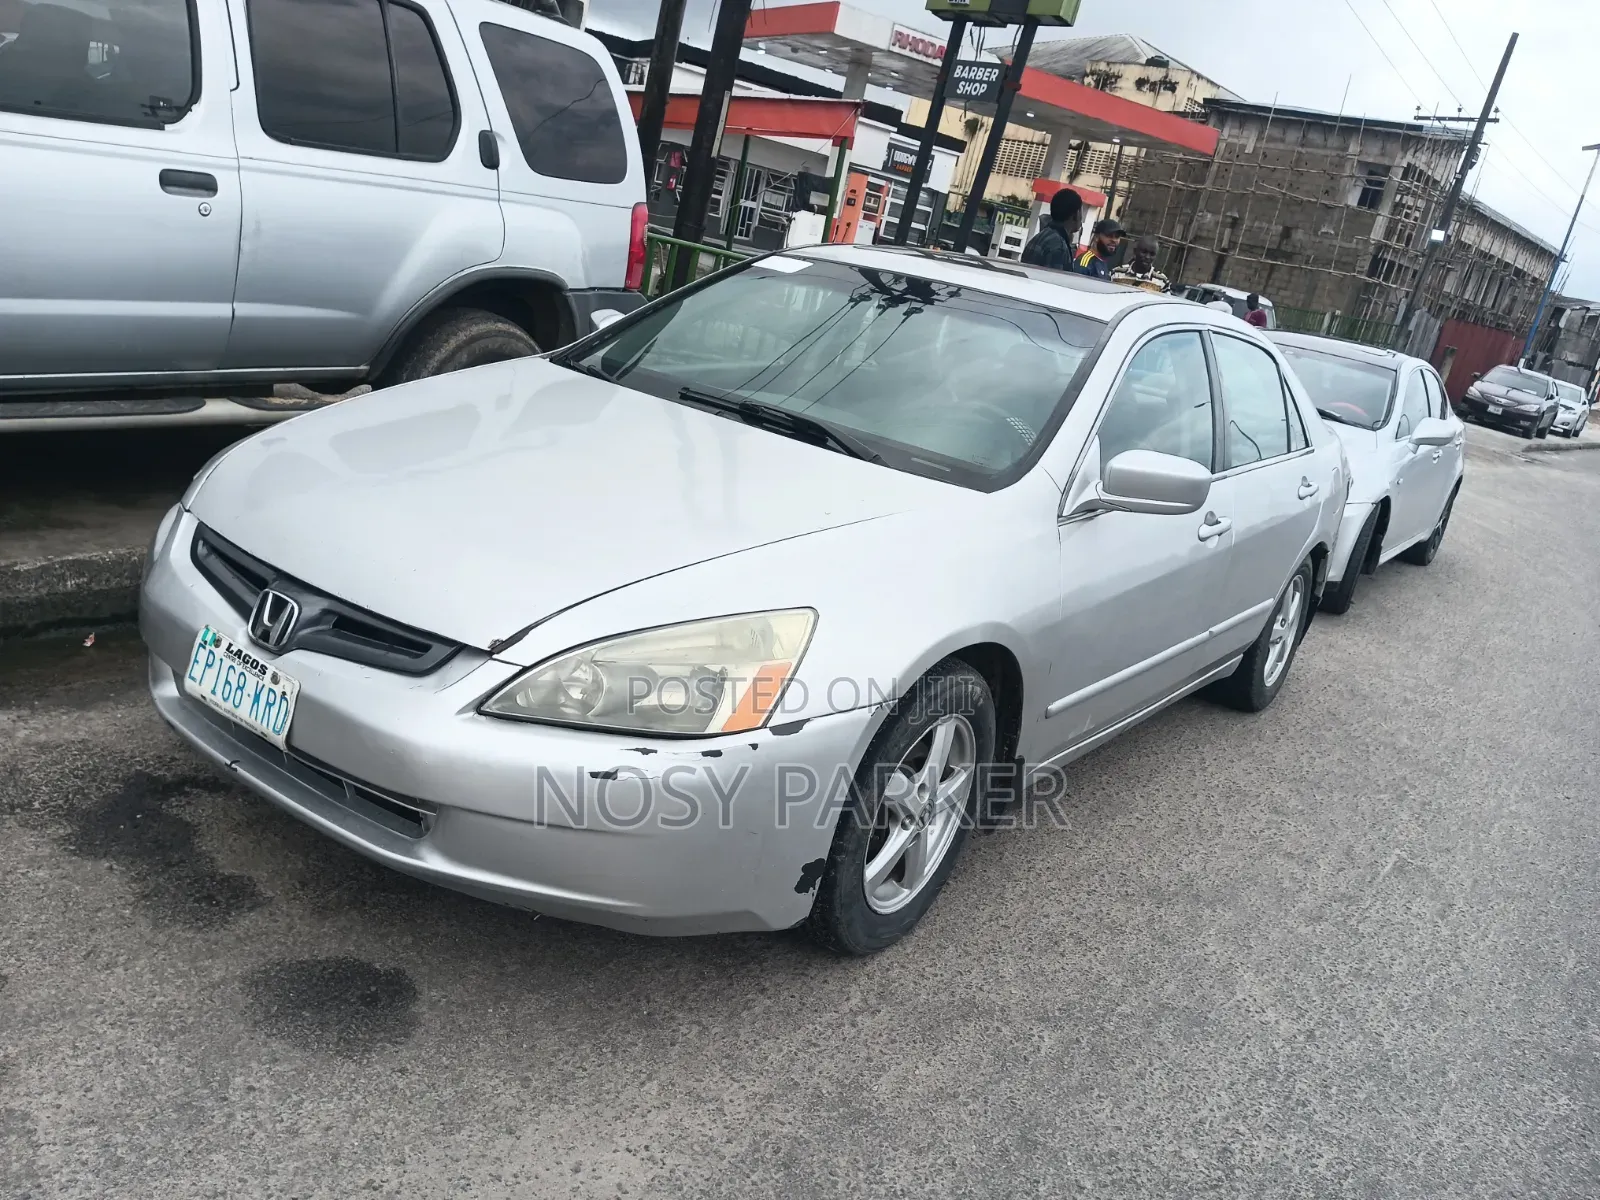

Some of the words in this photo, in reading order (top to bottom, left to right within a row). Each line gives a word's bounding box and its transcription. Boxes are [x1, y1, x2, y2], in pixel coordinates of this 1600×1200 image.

[954, 65, 999, 81] BARBER
[956, 81, 987, 96] SHOP
[225, 642, 268, 675] LAGOS
